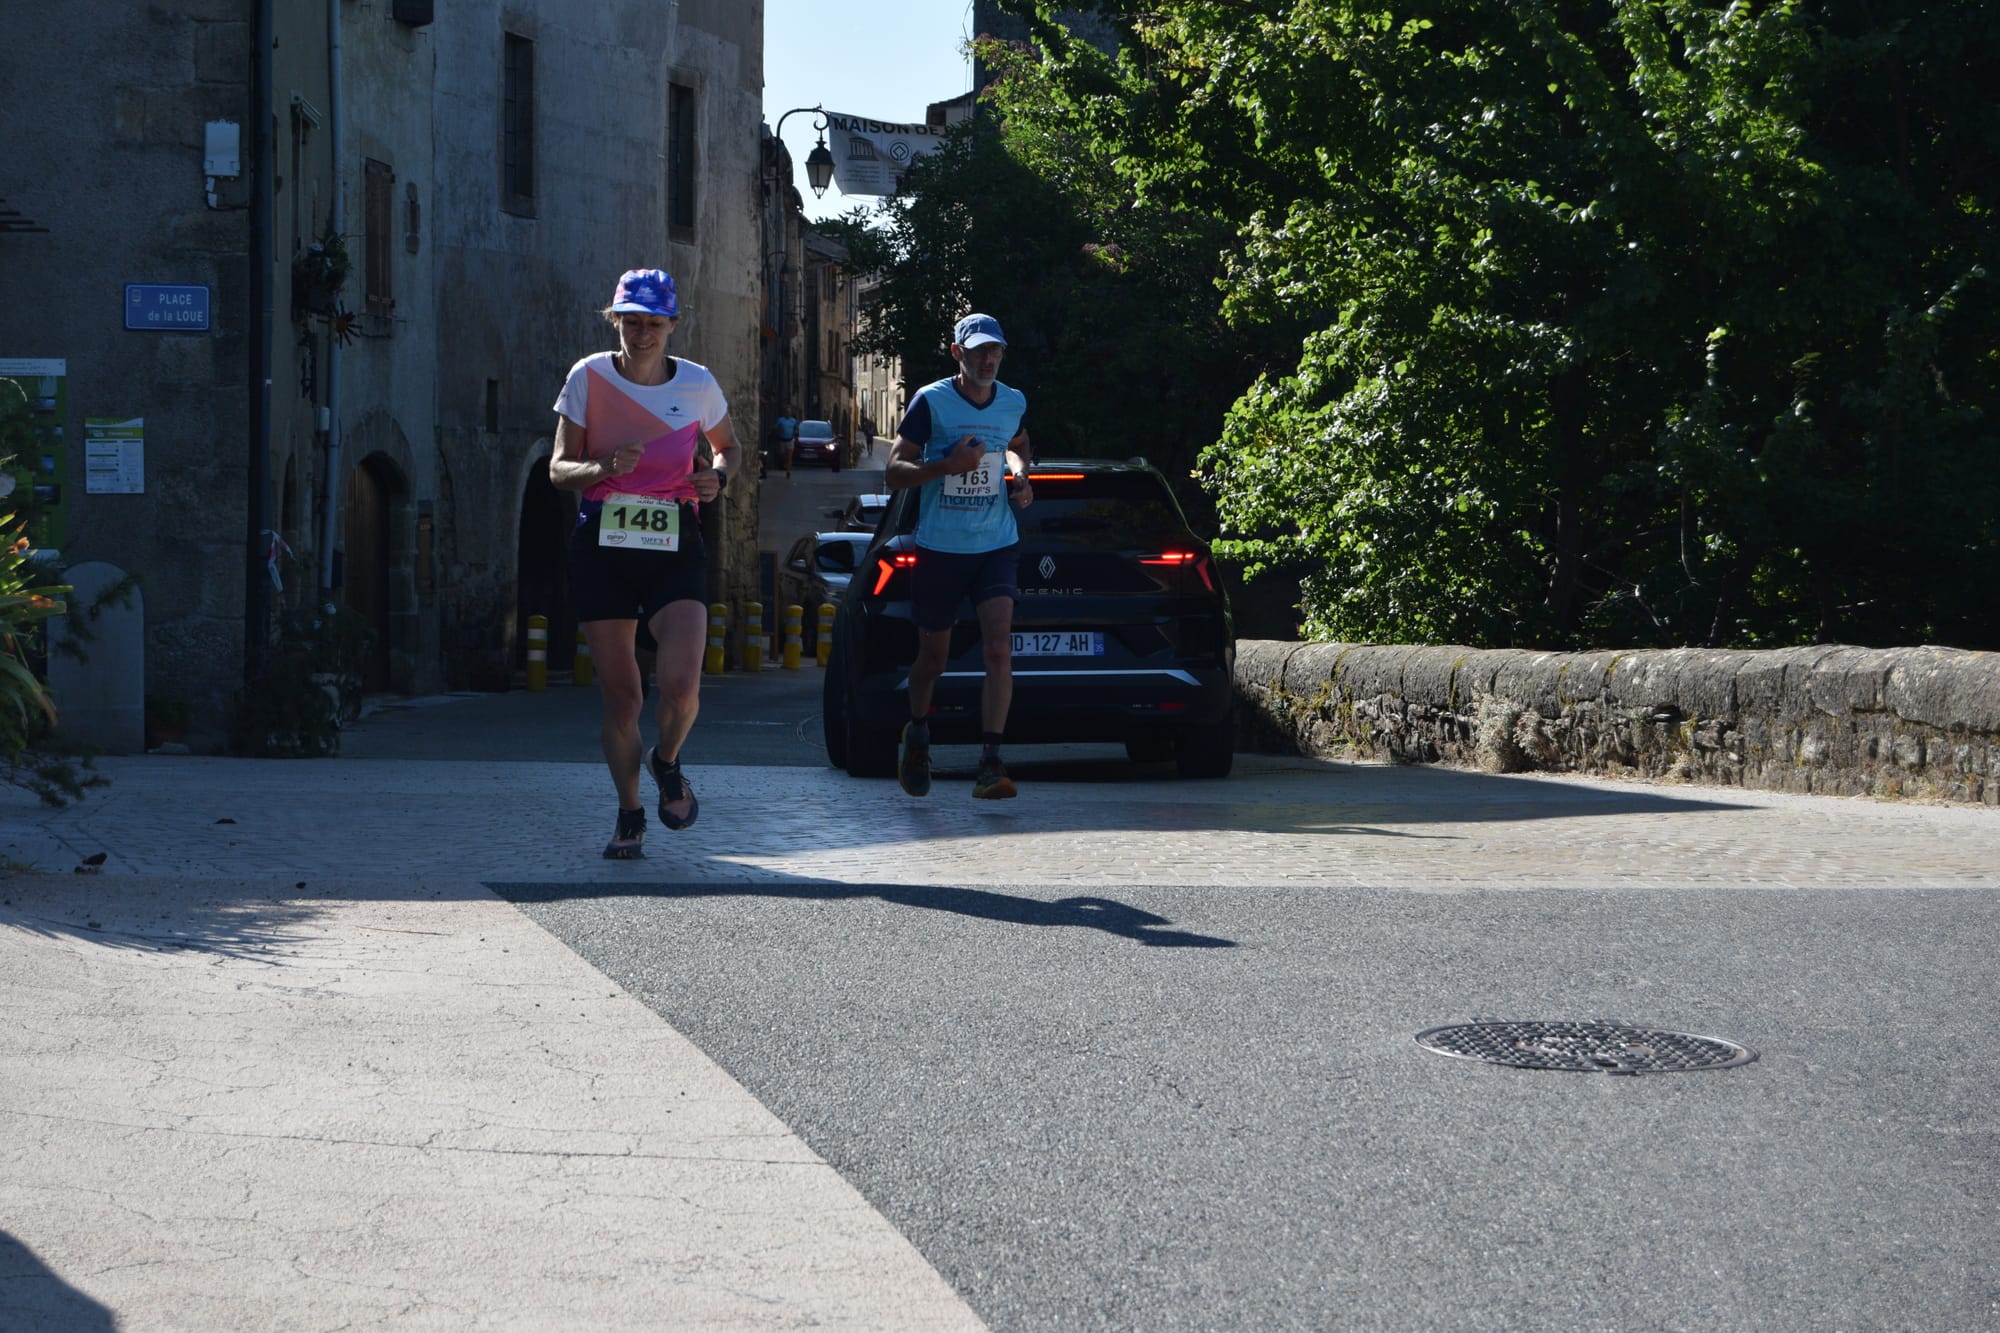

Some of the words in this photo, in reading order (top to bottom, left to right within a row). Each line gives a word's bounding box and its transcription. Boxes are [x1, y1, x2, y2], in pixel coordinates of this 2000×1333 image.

[832, 117, 909, 134] MAISON
[915, 125, 940, 136] DE
[159, 293, 192, 305] PLACE
[148, 310, 160, 321] de
[164, 310, 173, 321] la
[176, 311, 204, 322] LOUE
[959, 470, 989, 486] 163
[956, 486, 991, 496] TUFF'S
[613, 506, 668, 532] 148
